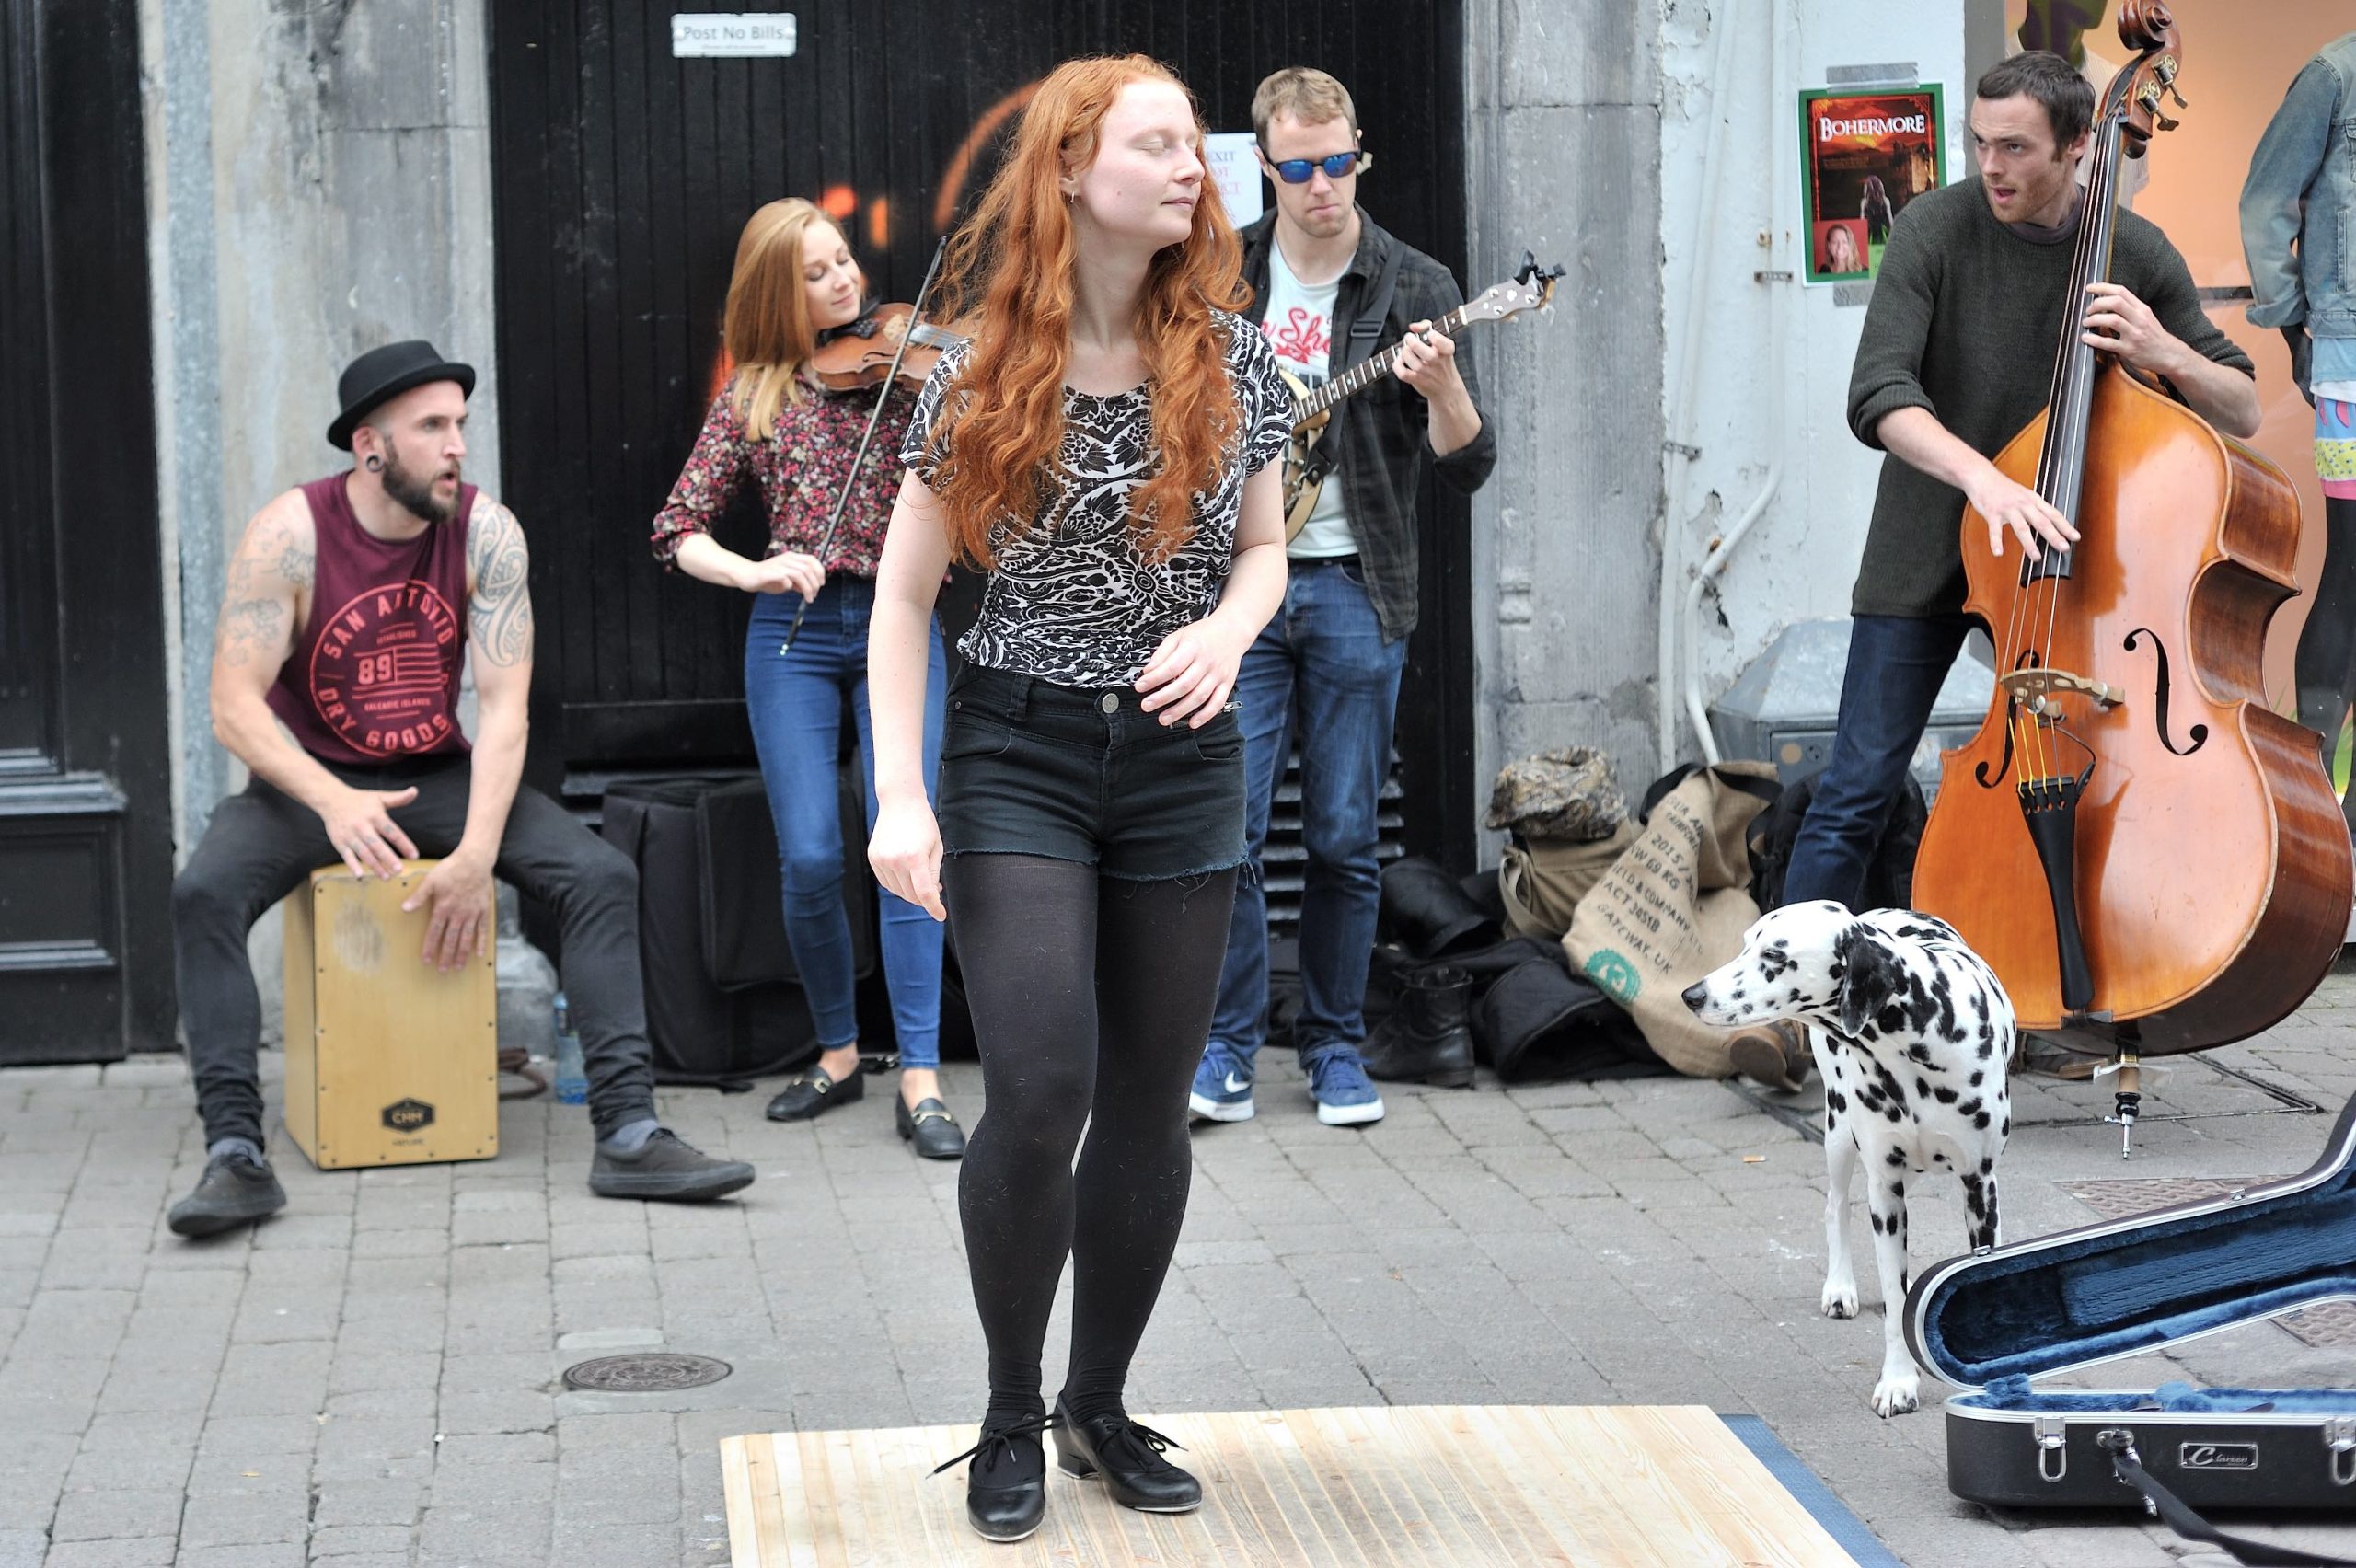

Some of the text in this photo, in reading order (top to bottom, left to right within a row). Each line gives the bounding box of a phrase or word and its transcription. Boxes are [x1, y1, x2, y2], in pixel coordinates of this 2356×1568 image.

[684, 26, 782, 40] Post No Bills
[1819, 114, 1925, 142] BOHERMORE
[323, 609, 366, 659] SAN
[359, 653, 392, 686] 89
[318, 688, 448, 751] DRY GOODS
[1645, 888, 1690, 931] COMPANY
[1654, 952, 1672, 974] UK
